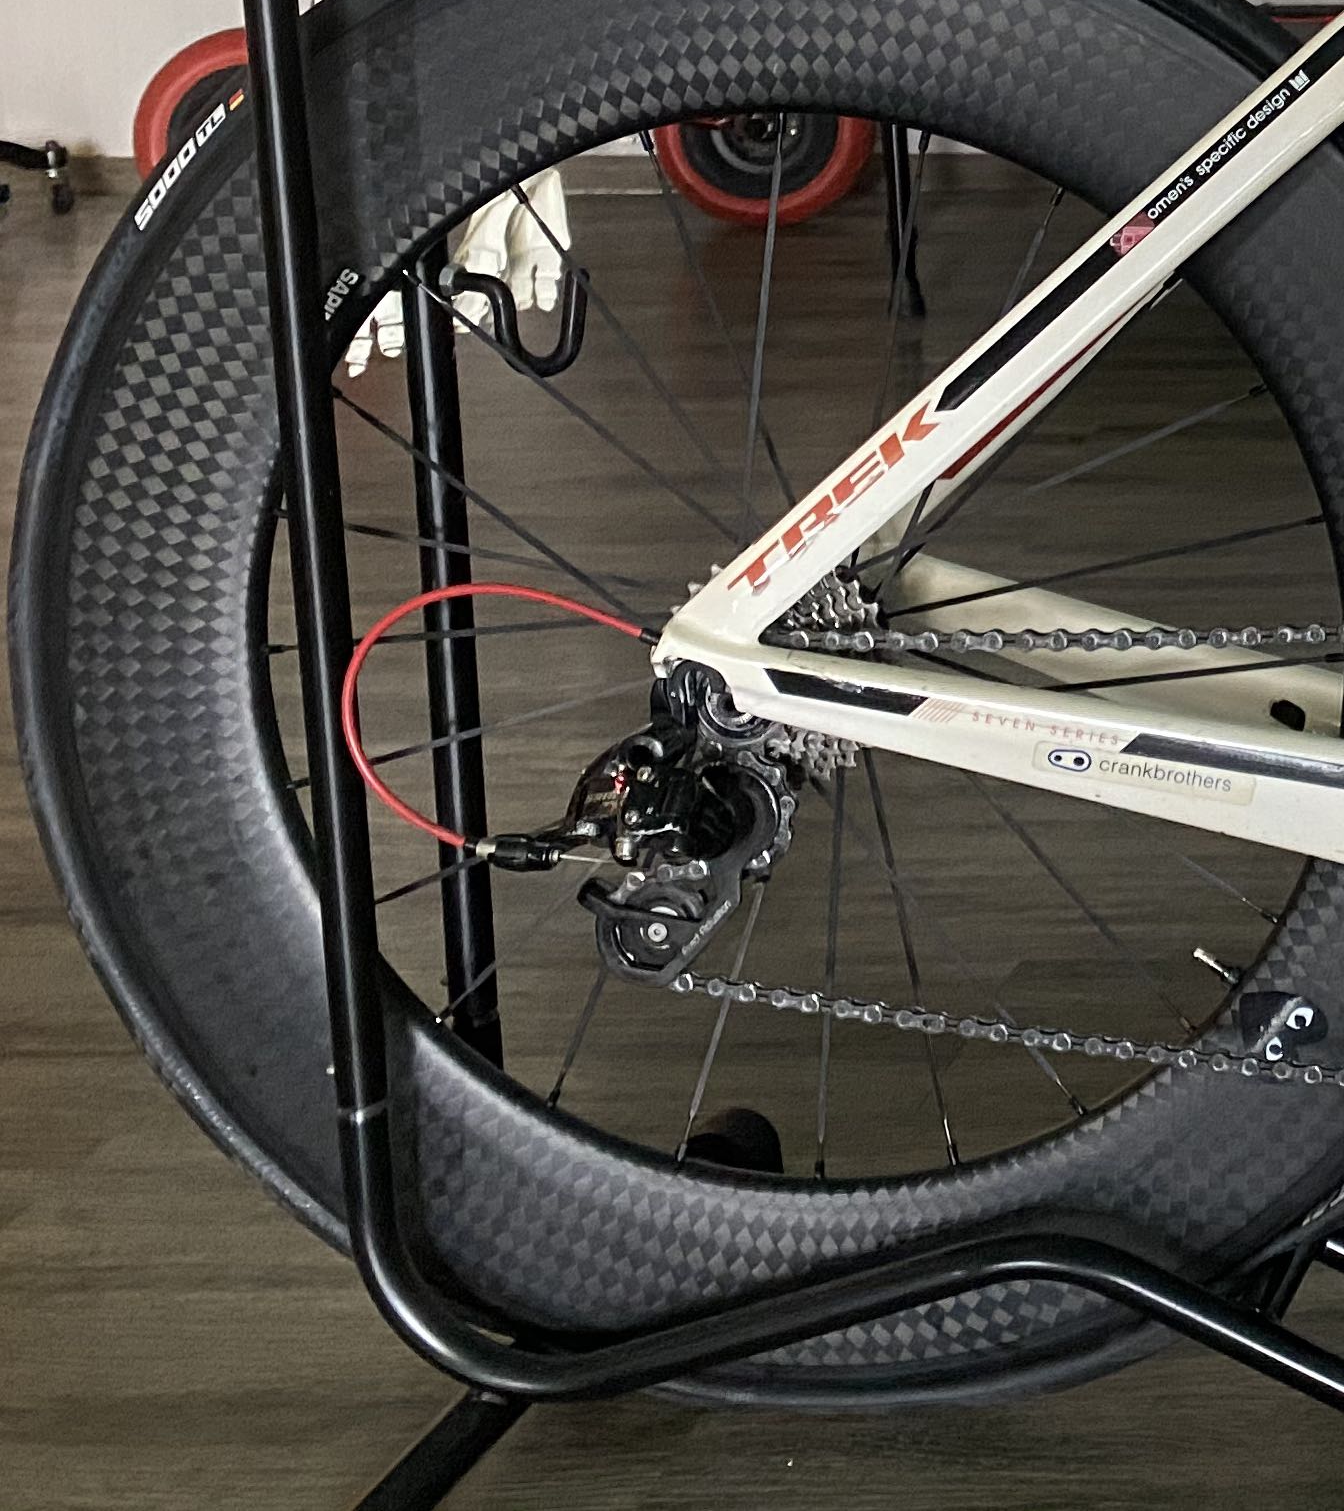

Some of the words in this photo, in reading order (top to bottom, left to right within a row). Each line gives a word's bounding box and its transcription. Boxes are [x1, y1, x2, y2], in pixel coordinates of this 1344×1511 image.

[133, 137, 198, 231] 5000
[1147, 174, 1194, 220] omen's
[1195, 126, 1247, 177] specific
[1246, 88, 1291, 131] design
[727, 400, 940, 596] TREK
[971, 710, 1036, 732] SEVEN
[1050, 724, 1120, 746] SERIES
[1099, 758, 1232, 793] crankbrothers
